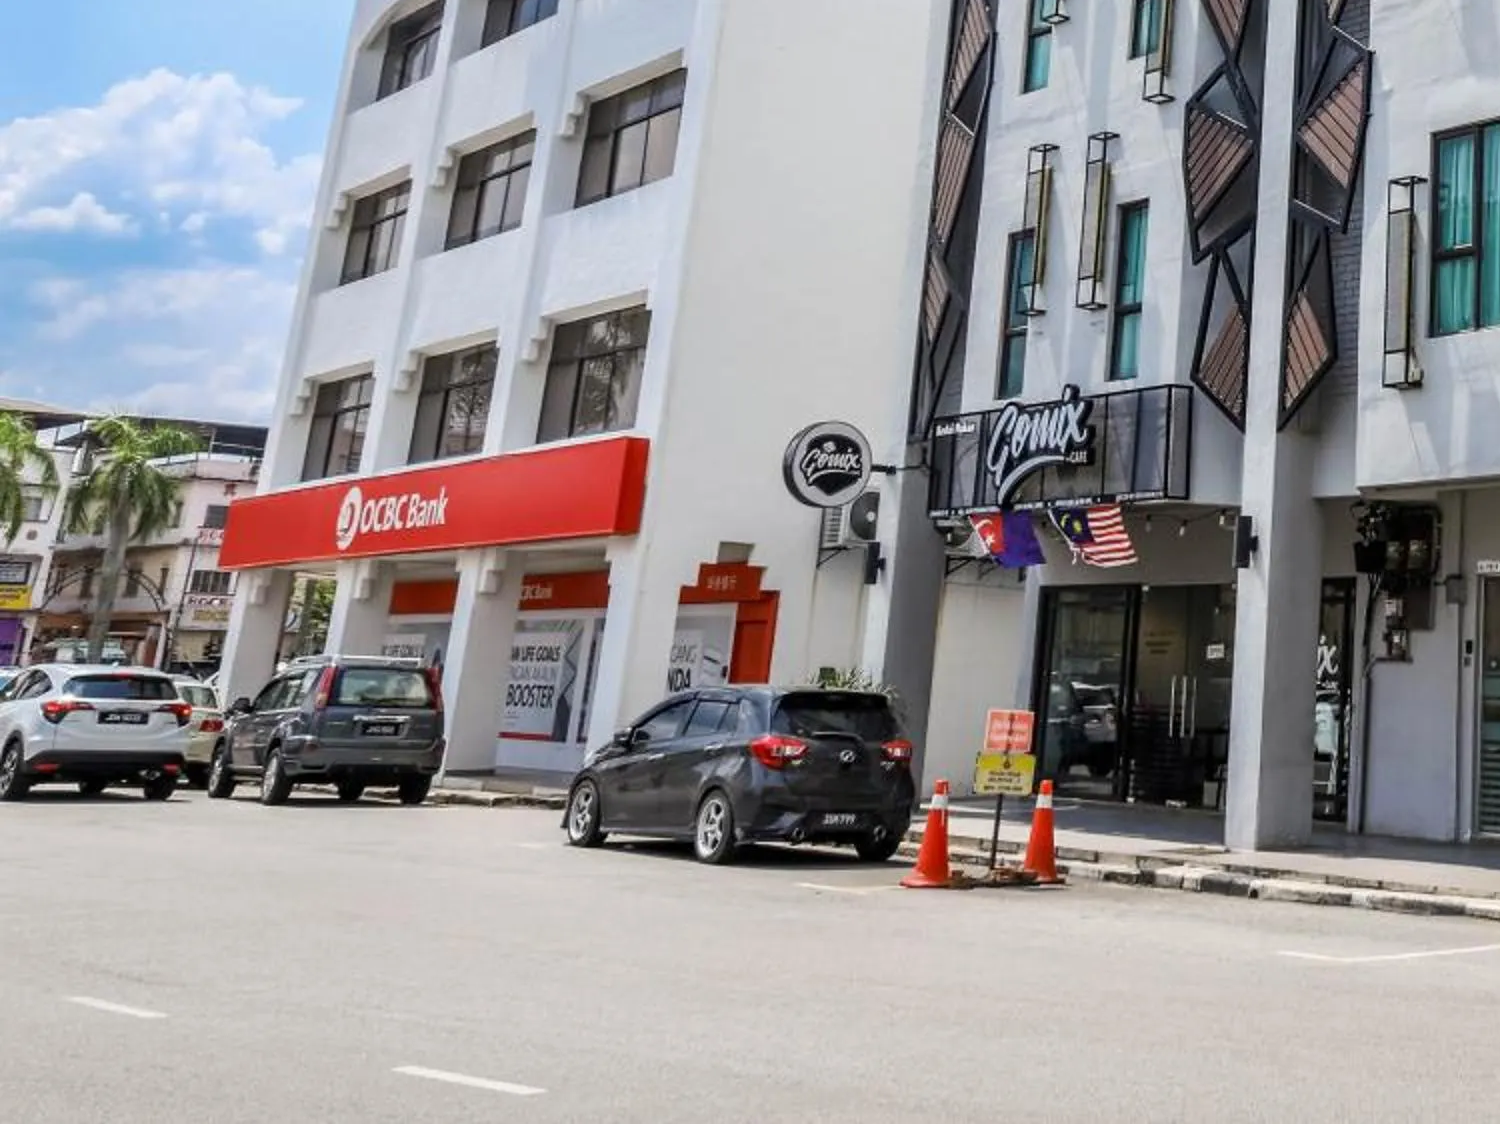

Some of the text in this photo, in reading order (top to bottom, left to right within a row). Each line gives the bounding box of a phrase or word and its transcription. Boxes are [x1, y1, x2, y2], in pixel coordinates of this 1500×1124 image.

[360, 486, 448, 535] OCBC Bank
[505, 683, 555, 709] BOOSTER
